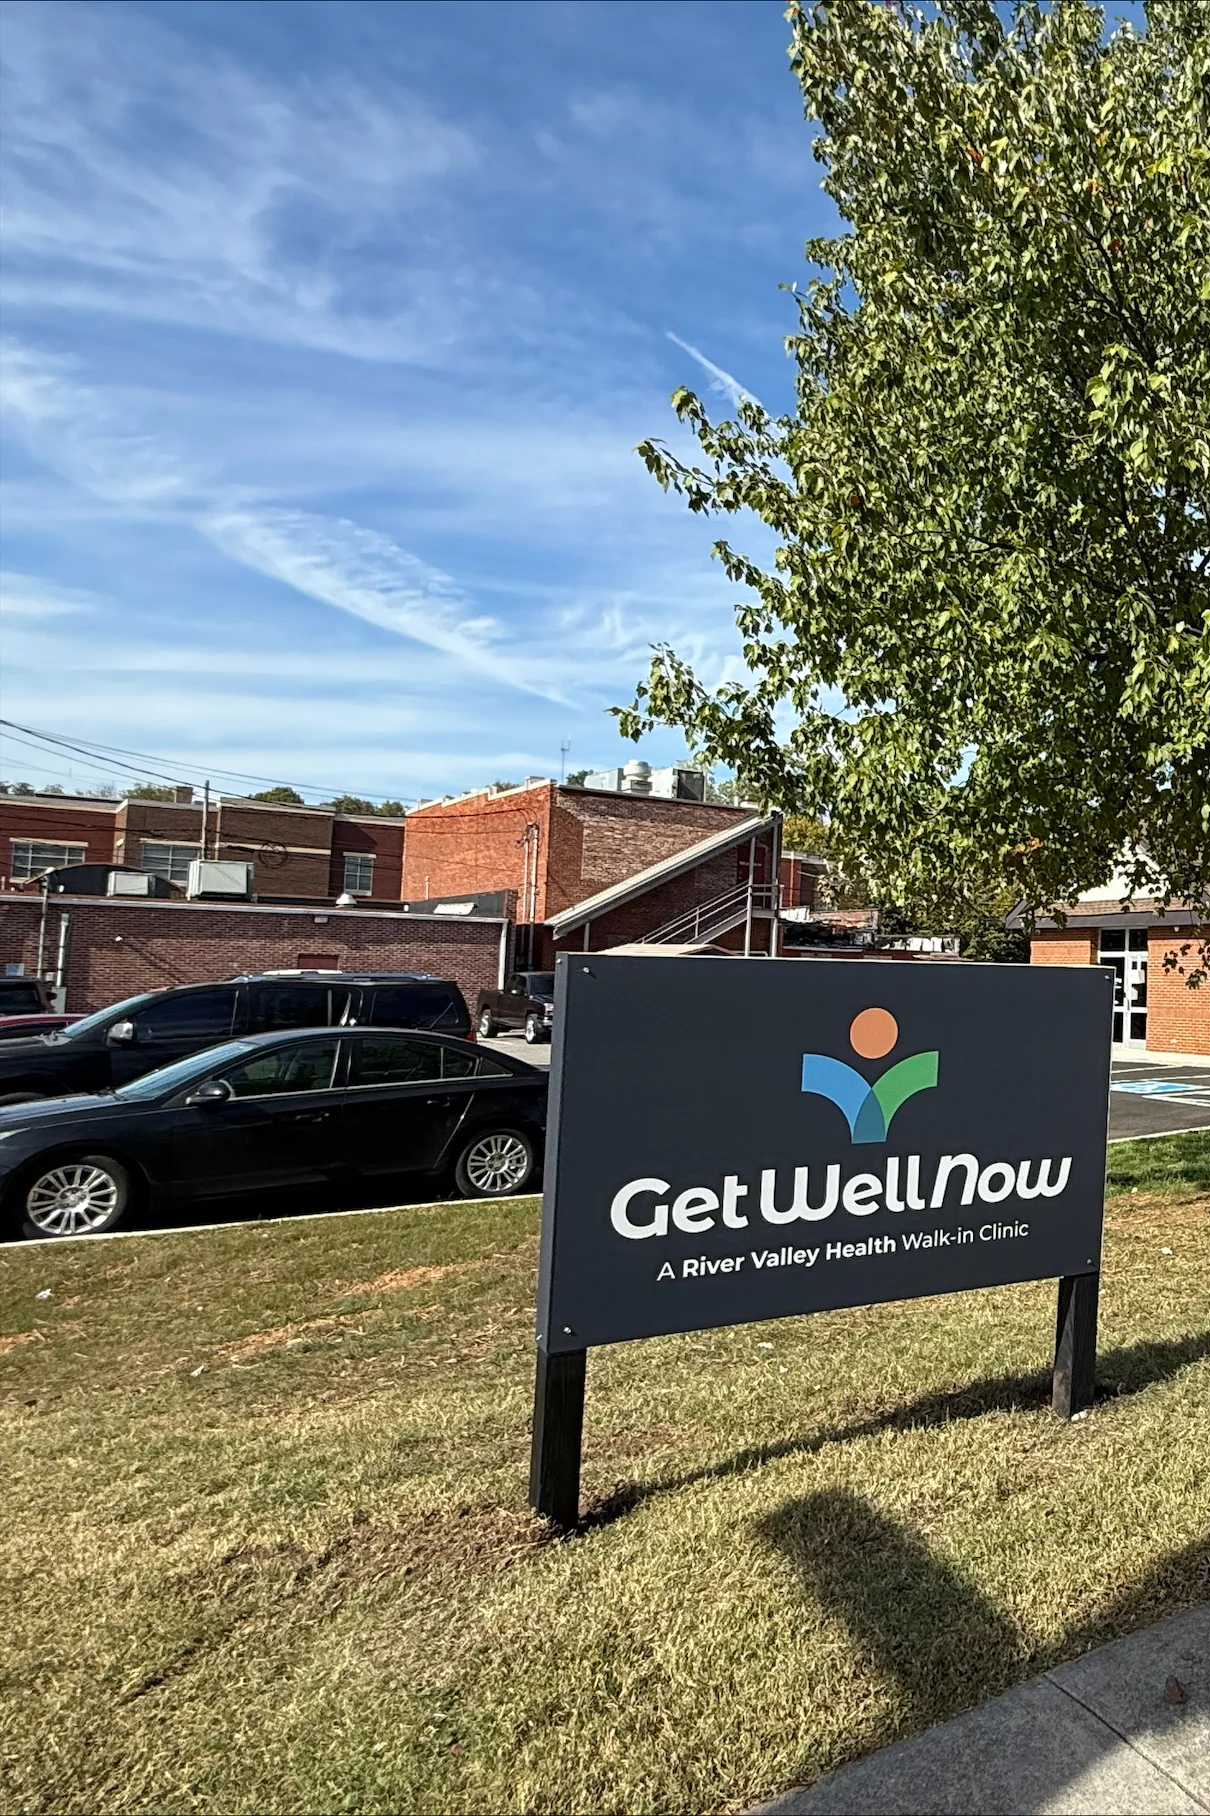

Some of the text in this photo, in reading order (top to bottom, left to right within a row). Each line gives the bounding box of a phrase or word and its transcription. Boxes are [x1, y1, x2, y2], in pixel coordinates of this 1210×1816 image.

[656, 1219, 1030, 1282] A River Valley Health Walk-in Clinic
